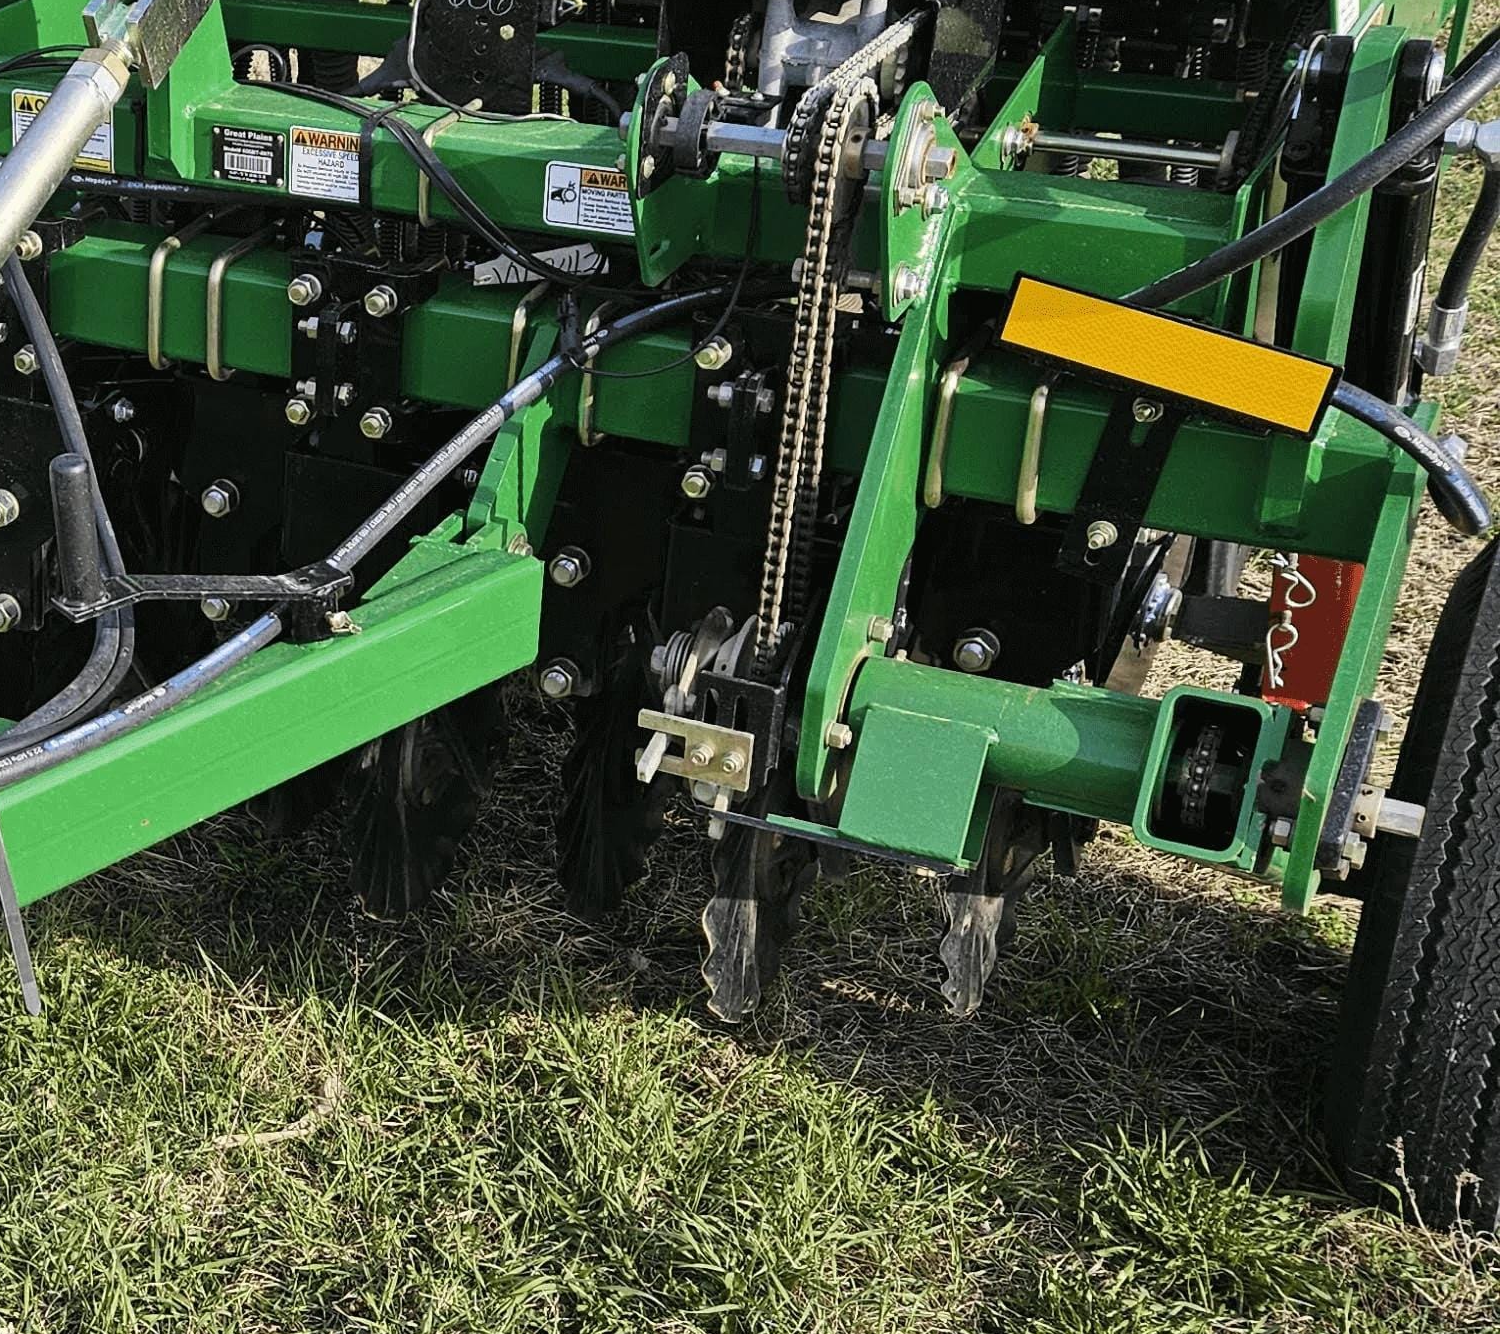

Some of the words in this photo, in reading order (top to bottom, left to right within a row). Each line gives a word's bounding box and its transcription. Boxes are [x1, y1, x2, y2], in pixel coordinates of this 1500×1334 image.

[224, 128, 247, 139] Great
[247, 131, 273, 142] Plains
[307, 131, 360, 151] WARNIN
[302, 146, 337, 159] EXCESSIVE
[318, 158, 345, 169] HAZARD
[581, 188, 606, 198] MOVING
[606, 191, 627, 200] PARTS
